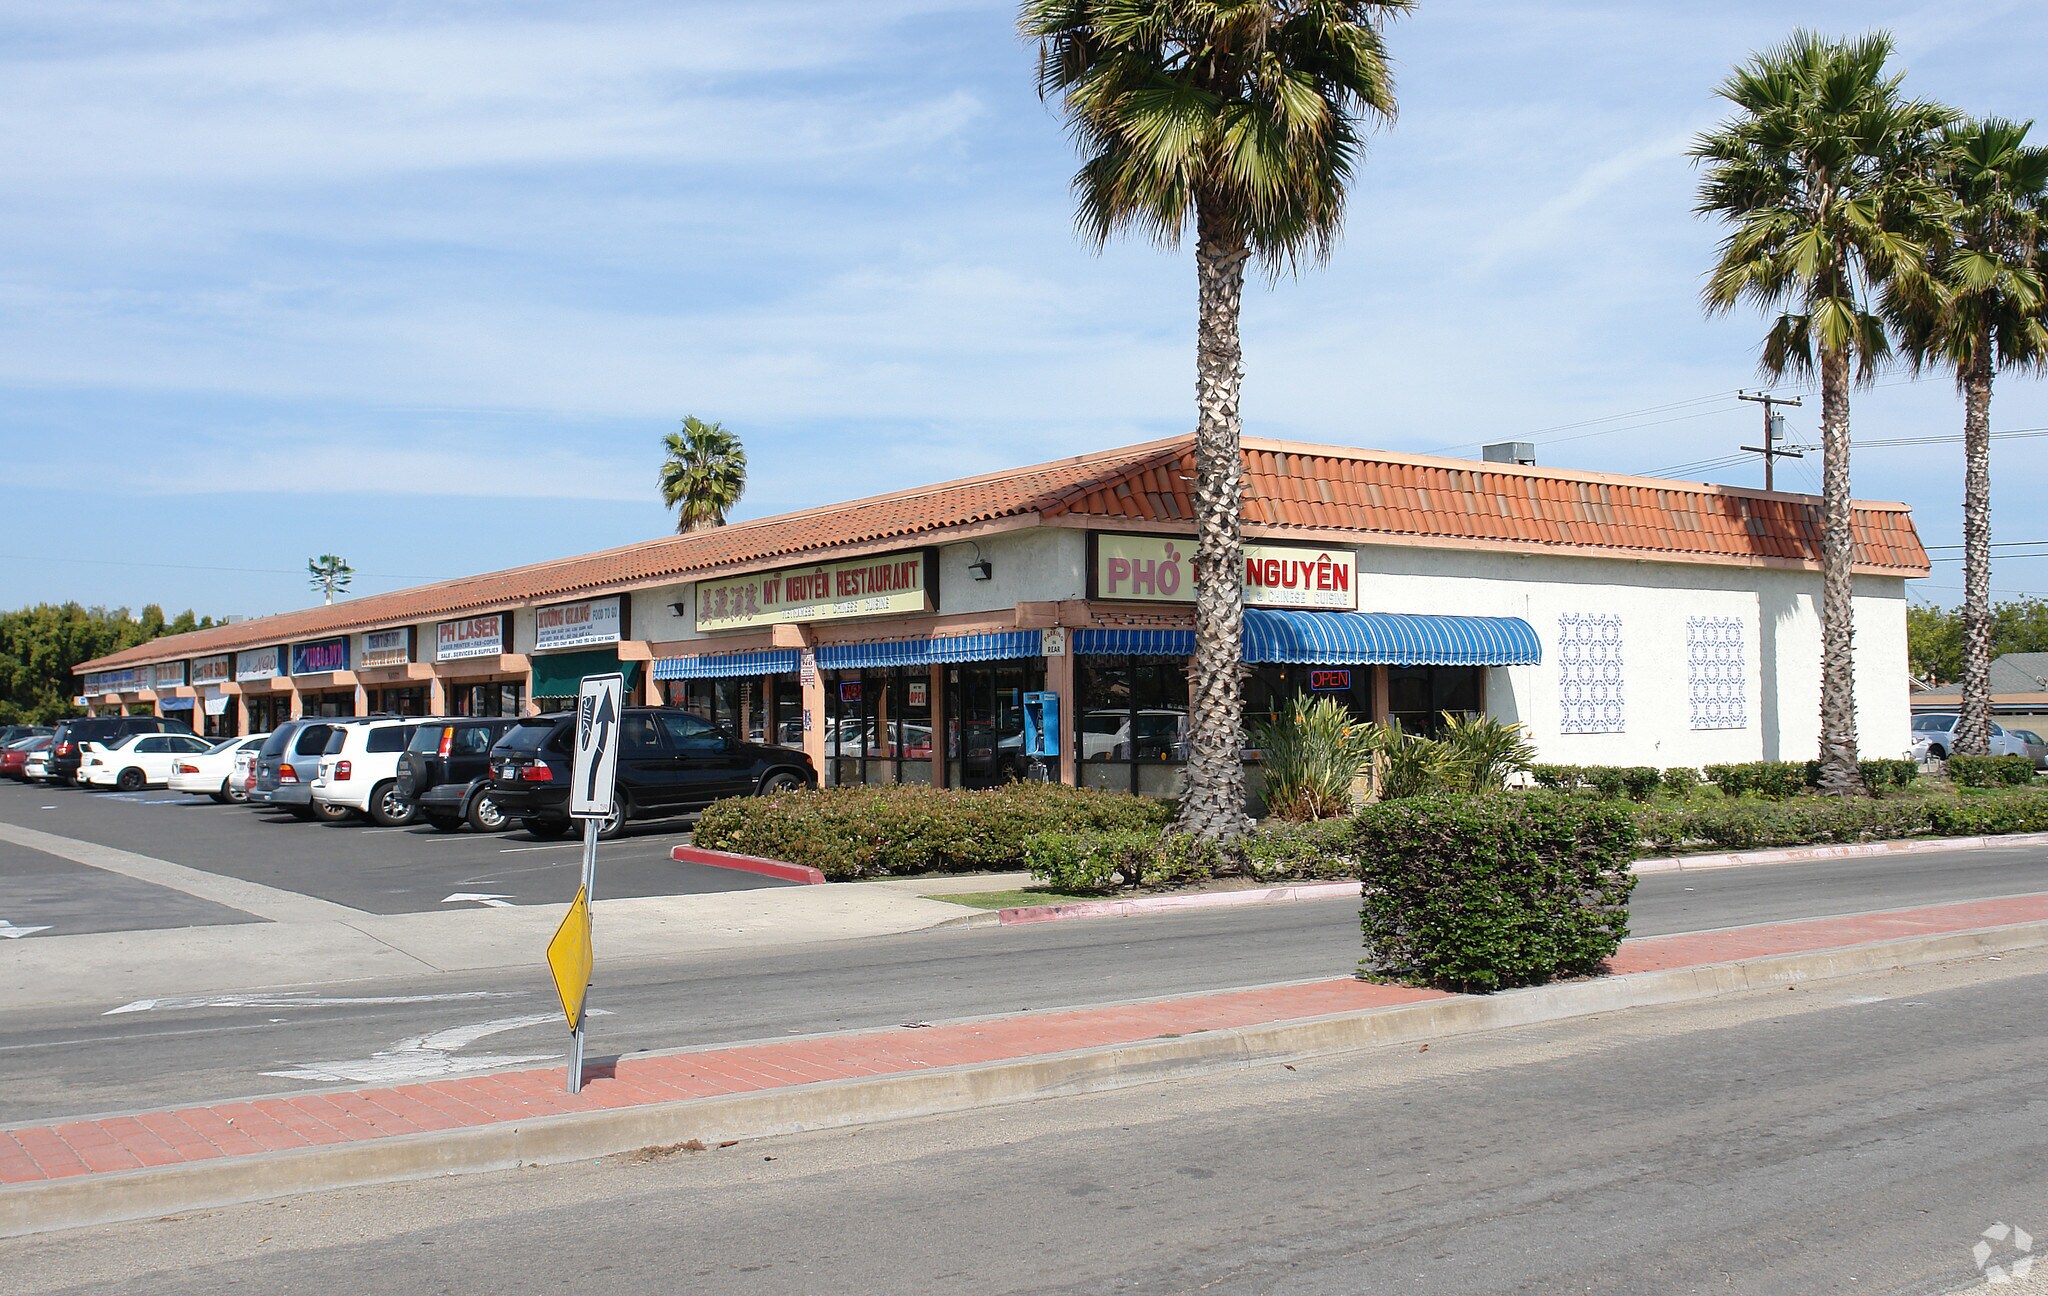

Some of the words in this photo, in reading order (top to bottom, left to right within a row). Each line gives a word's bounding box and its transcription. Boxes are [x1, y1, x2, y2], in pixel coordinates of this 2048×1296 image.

[1107, 542, 1181, 595] PHỞ
[1246, 552, 1349, 591] NGUYÊN
[786, 567, 830, 602] NGUYÊN
[836, 560, 919, 597] RESTAURANT
[1268, 590, 1306, 604] CHINESE
[1314, 592, 1348, 605] CUISINE
[592, 608, 603, 620] FOOD
[440, 622, 455, 643] PH
[458, 617, 499, 640] LASER
[1043, 630, 1063, 642] PARKING
[454, 641, 470, 649] PRINTER
[1312, 671, 1348, 687] OPEN
[911, 692, 925, 704] OPEN
